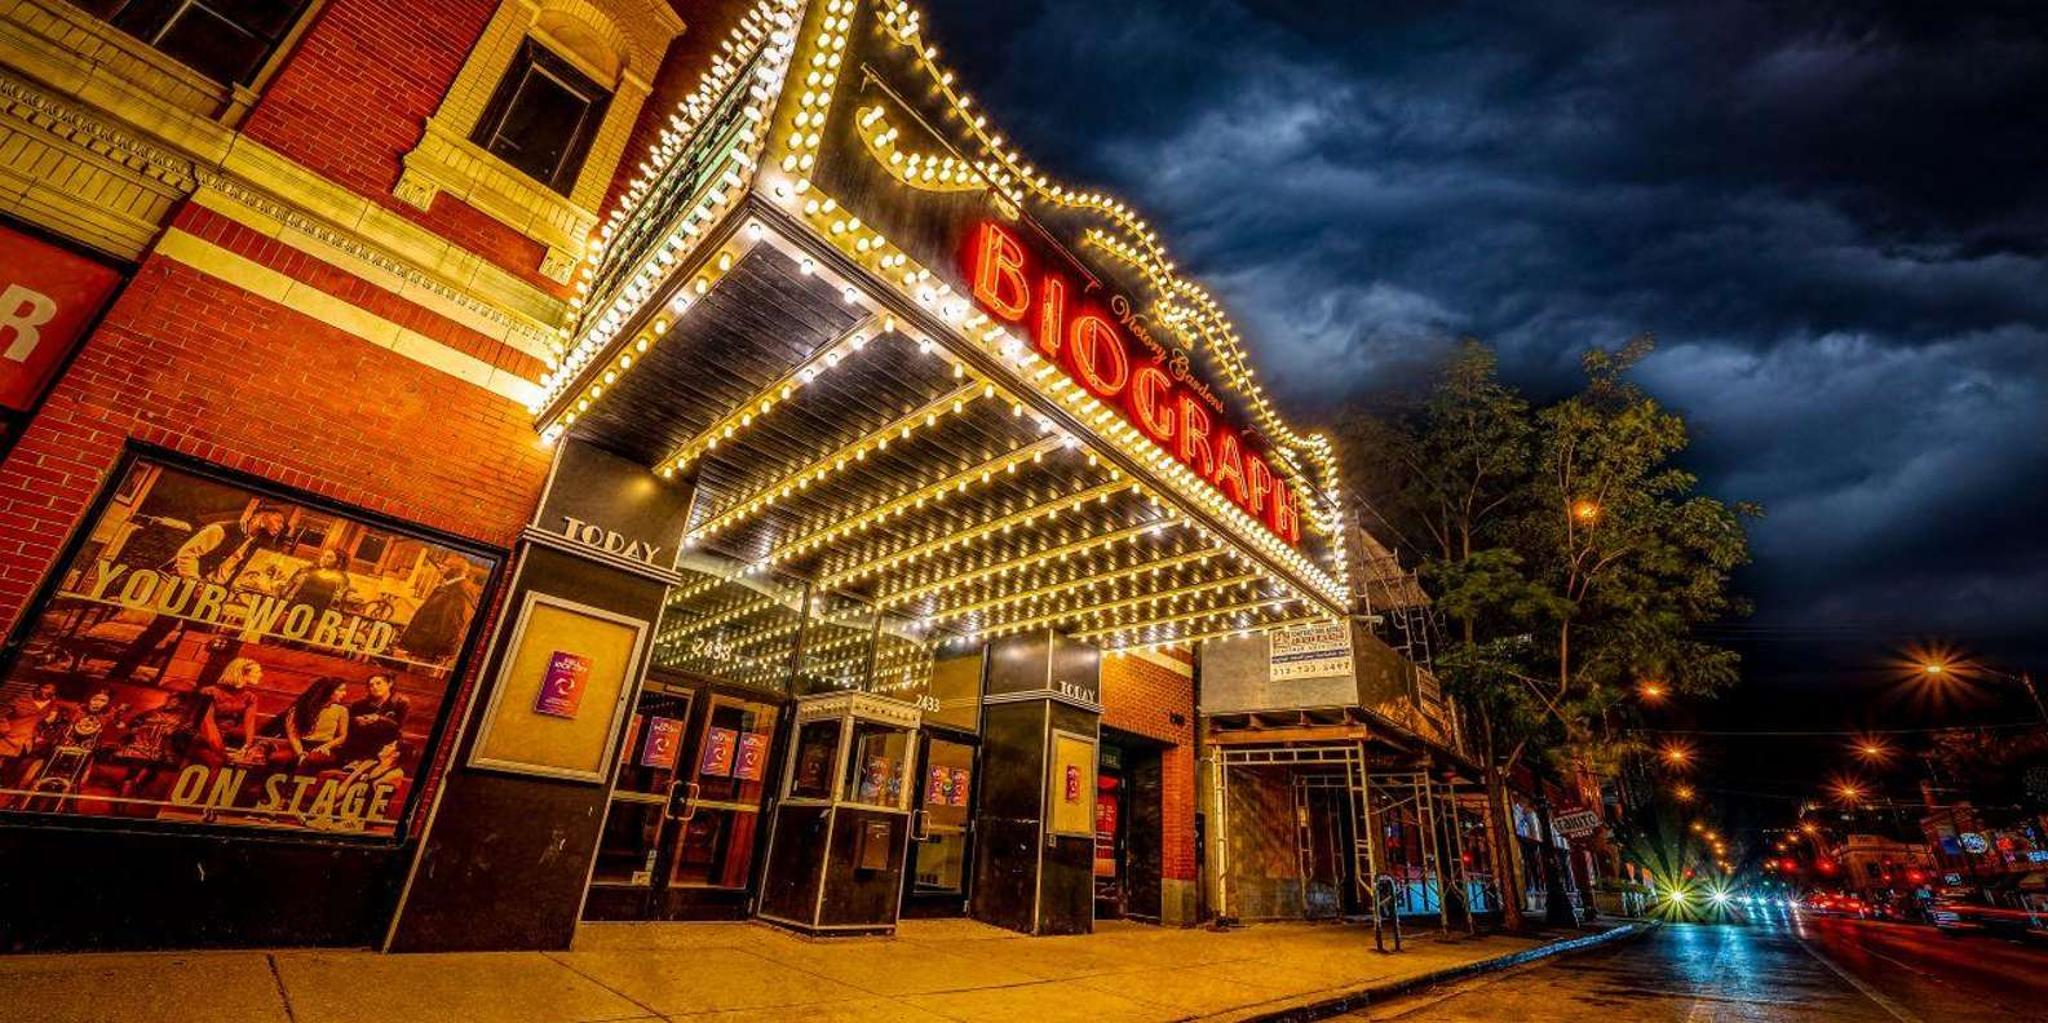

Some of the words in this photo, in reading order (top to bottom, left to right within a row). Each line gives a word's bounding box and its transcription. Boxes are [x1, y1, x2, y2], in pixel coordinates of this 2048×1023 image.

[1111, 294, 1167, 365] Victory
[973, 222, 1300, 543] BIOGRAPH
[563, 515, 661, 565] TODAY
[91, 559, 229, 625] YOUR
[242, 591, 395, 655] WORLD
[913, 693, 940, 713] 2433
[1060, 680, 1096, 704] TODAY
[170, 764, 247, 808] ON
[256, 772, 395, 823] STAGE
